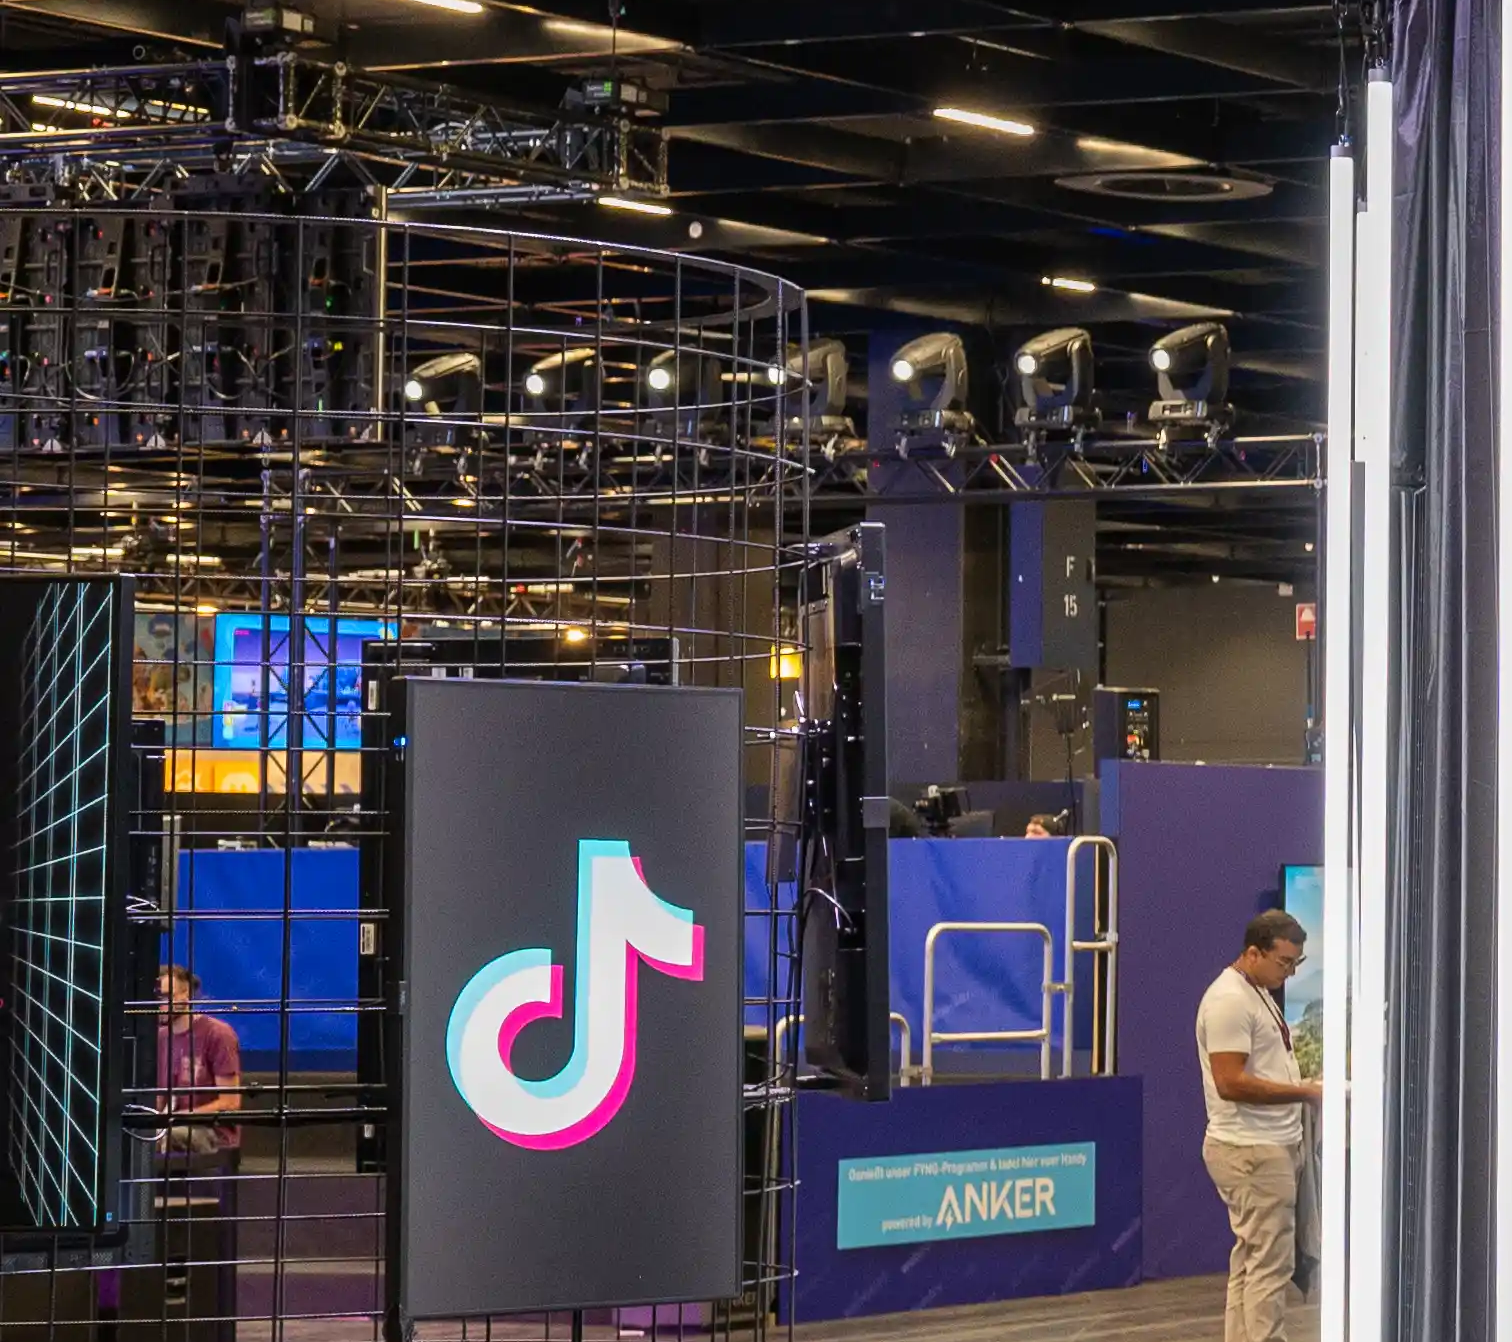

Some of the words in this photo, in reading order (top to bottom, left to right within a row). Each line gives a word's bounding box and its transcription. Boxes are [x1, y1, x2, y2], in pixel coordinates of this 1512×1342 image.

[1066, 556, 1075, 578] F
[1064, 595, 1078, 617] 15
[936, 1177, 1056, 1230] ANKER
